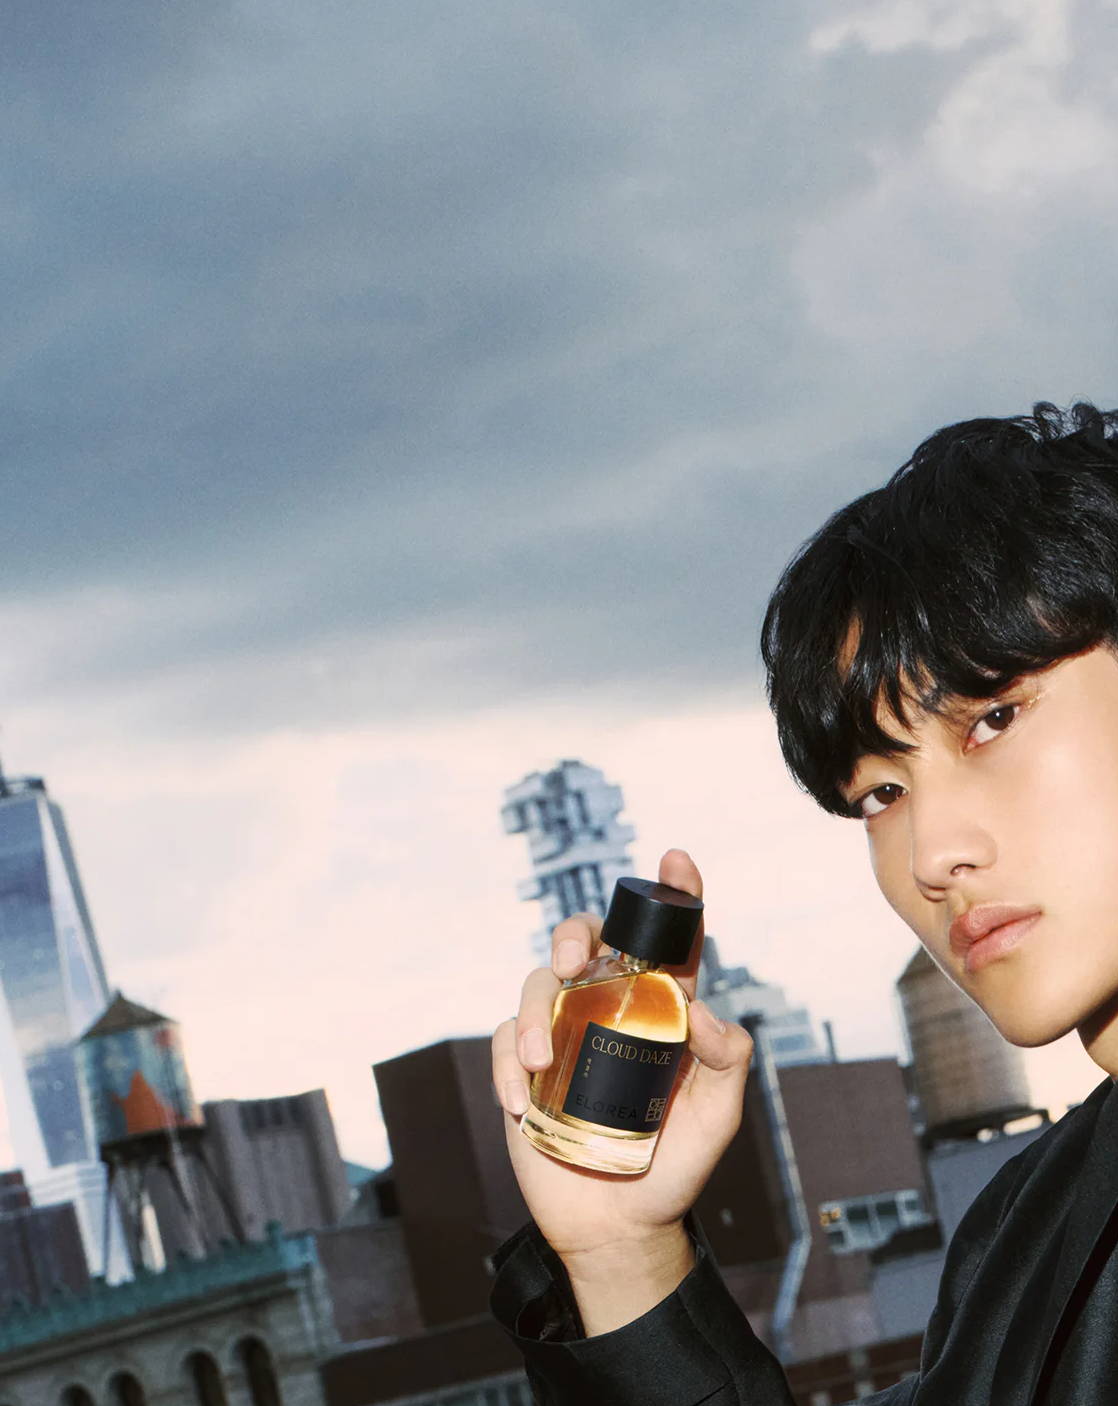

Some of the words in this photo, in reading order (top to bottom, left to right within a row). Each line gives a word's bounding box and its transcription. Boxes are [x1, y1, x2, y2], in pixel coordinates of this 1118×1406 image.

[591, 1035, 638, 1060] CLOUD
[639, 1048, 673, 1065] DAZE
[576, 1095, 637, 1119] ELOREA
